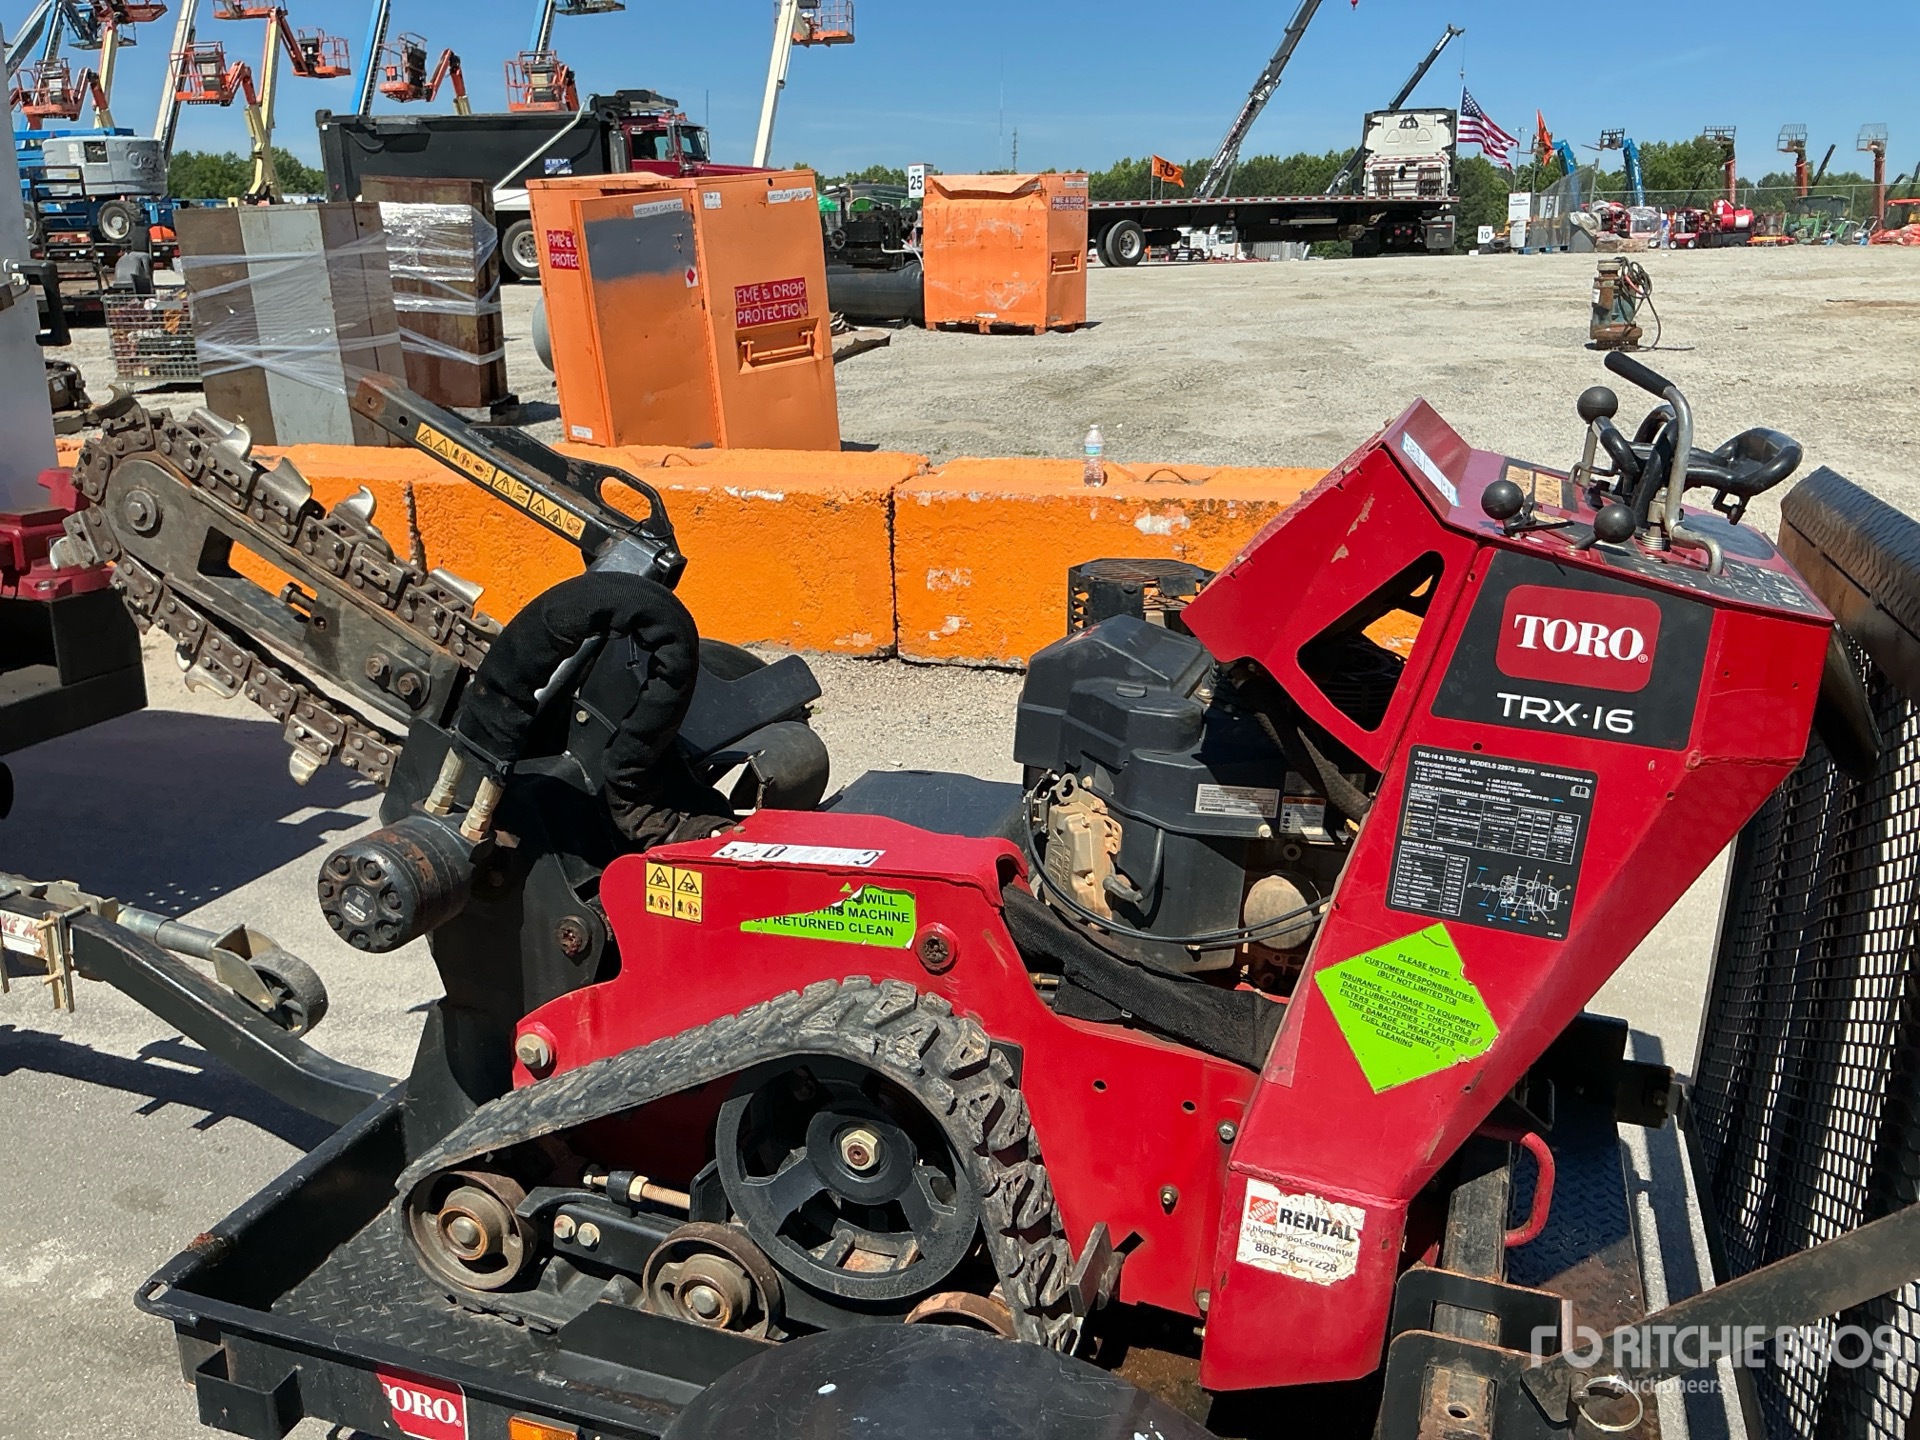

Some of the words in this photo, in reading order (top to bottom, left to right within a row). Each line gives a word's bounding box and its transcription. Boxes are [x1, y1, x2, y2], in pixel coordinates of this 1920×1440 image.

[910, 175, 922, 190] 25
[634, 206, 658, 216] MEDIUM
[660, 204, 672, 212] GAS
[1052, 196, 1064, 204] FME
[1480, 232, 1490, 240] 10
[736, 286, 759, 302] FME
[773, 282, 805, 297] DROP
[737, 302, 808, 324] PROTECTION
[1514, 614, 1645, 661] TORO
[1414, 760, 1457, 772] CHECK/SERVICE
[1418, 751, 1438, 760] TRX-16
[1445, 756, 1466, 764] TRX-20
[1470, 760, 1497, 769] MODELS
[1556, 774, 1584, 782] REFERENCE
[1410, 783, 1479, 797] SPECIFICATIONS/CHANGE
[1480, 792, 1510, 802] INTERVALS
[1401, 840, 1424, 848] SERVICE
[864, 894, 897, 906] WILL
[848, 908, 910, 923] MACHINE
[773, 916, 844, 932] RETURNED
[848, 924, 894, 936] CLEAN
[1364, 956, 1406, 976] CUSTOMER
[1398, 954, 1428, 970] PLEASE
[1430, 964, 1452, 979] NOTE:
[1377, 970, 1395, 982] (BUT
[1396, 976, 1412, 988] NOT
[1414, 982, 1444, 1000] LIMITED
[1444, 994, 1457, 1006] TO)
[1340, 970, 1382, 992] INSURANCE
[1392, 990, 1424, 1007] DAMAGE
[1426, 1004, 1436, 1014] TO
[1437, 1008, 1480, 1030] EQUIPMENT
[1342, 981, 1366, 995] DAILY
[1368, 989, 1418, 1014] LUBRICATIONS
[1428, 1014, 1452, 1028] CHECK
[1454, 1024, 1472, 1036] OILS
[1340, 989, 1369, 1004] FILTERS
[1378, 1004, 1418, 1024] BATTERIES
[1428, 1022, 1448, 1035] FLAT
[1448, 1030, 1469, 1044] TIRES
[1348, 1000, 1366, 1012] TIRE
[1366, 1008, 1398, 1025] DAMAGE
[1407, 1022, 1430, 1036] WEAR
[1430, 1032, 1456, 1048] PARTS
[1360, 1014, 1380, 1026] FUEL
[1381, 1022, 1436, 1048] REPLACEMENT
[1376, 1028, 1413, 1048] CLEANING
[1279, 1208, 1356, 1242] RENTAL
